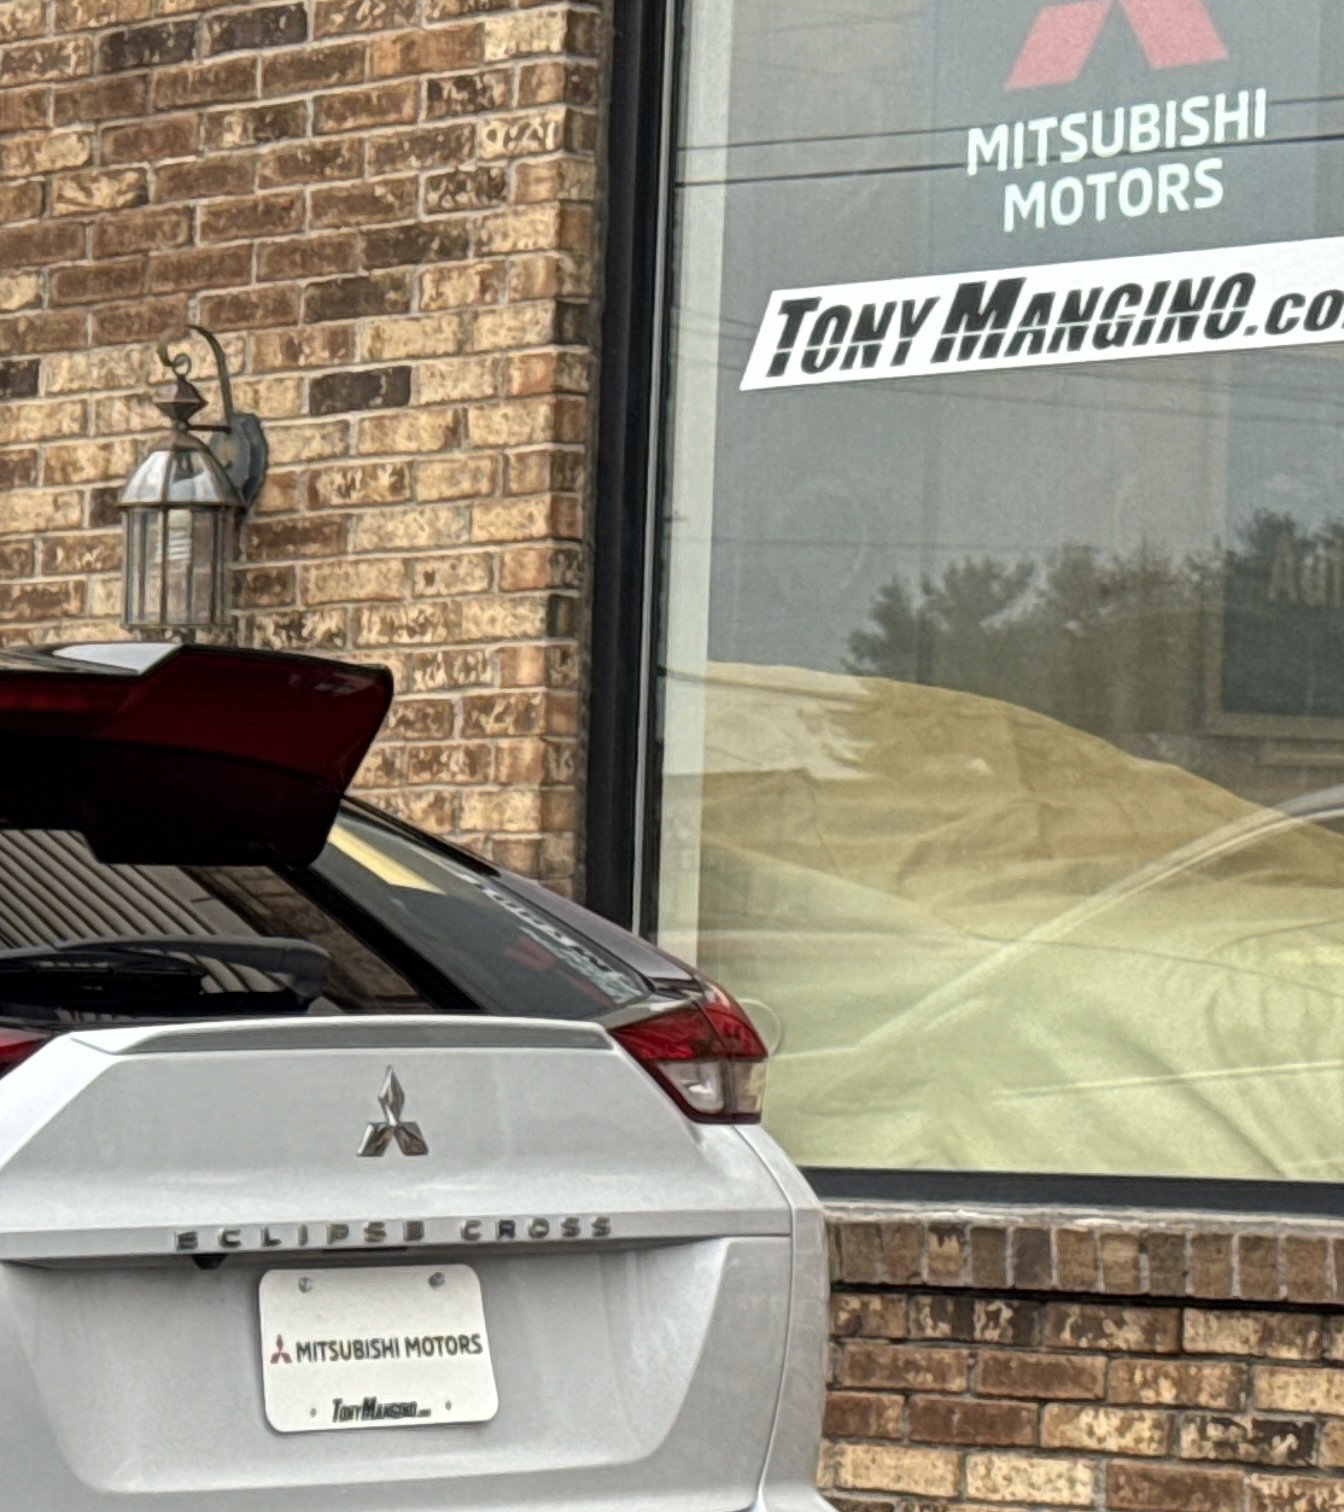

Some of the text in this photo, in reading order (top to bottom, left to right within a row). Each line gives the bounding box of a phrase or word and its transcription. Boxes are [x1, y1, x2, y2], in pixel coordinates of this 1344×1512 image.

[966, 88, 1267, 176] MITSUBISHI
[1003, 158, 1224, 232] MOTORS
[176, 1216, 611, 1251] ECLIPSE CROSS
[296, 1334, 483, 1363] MITSUBISHI MOTORS
